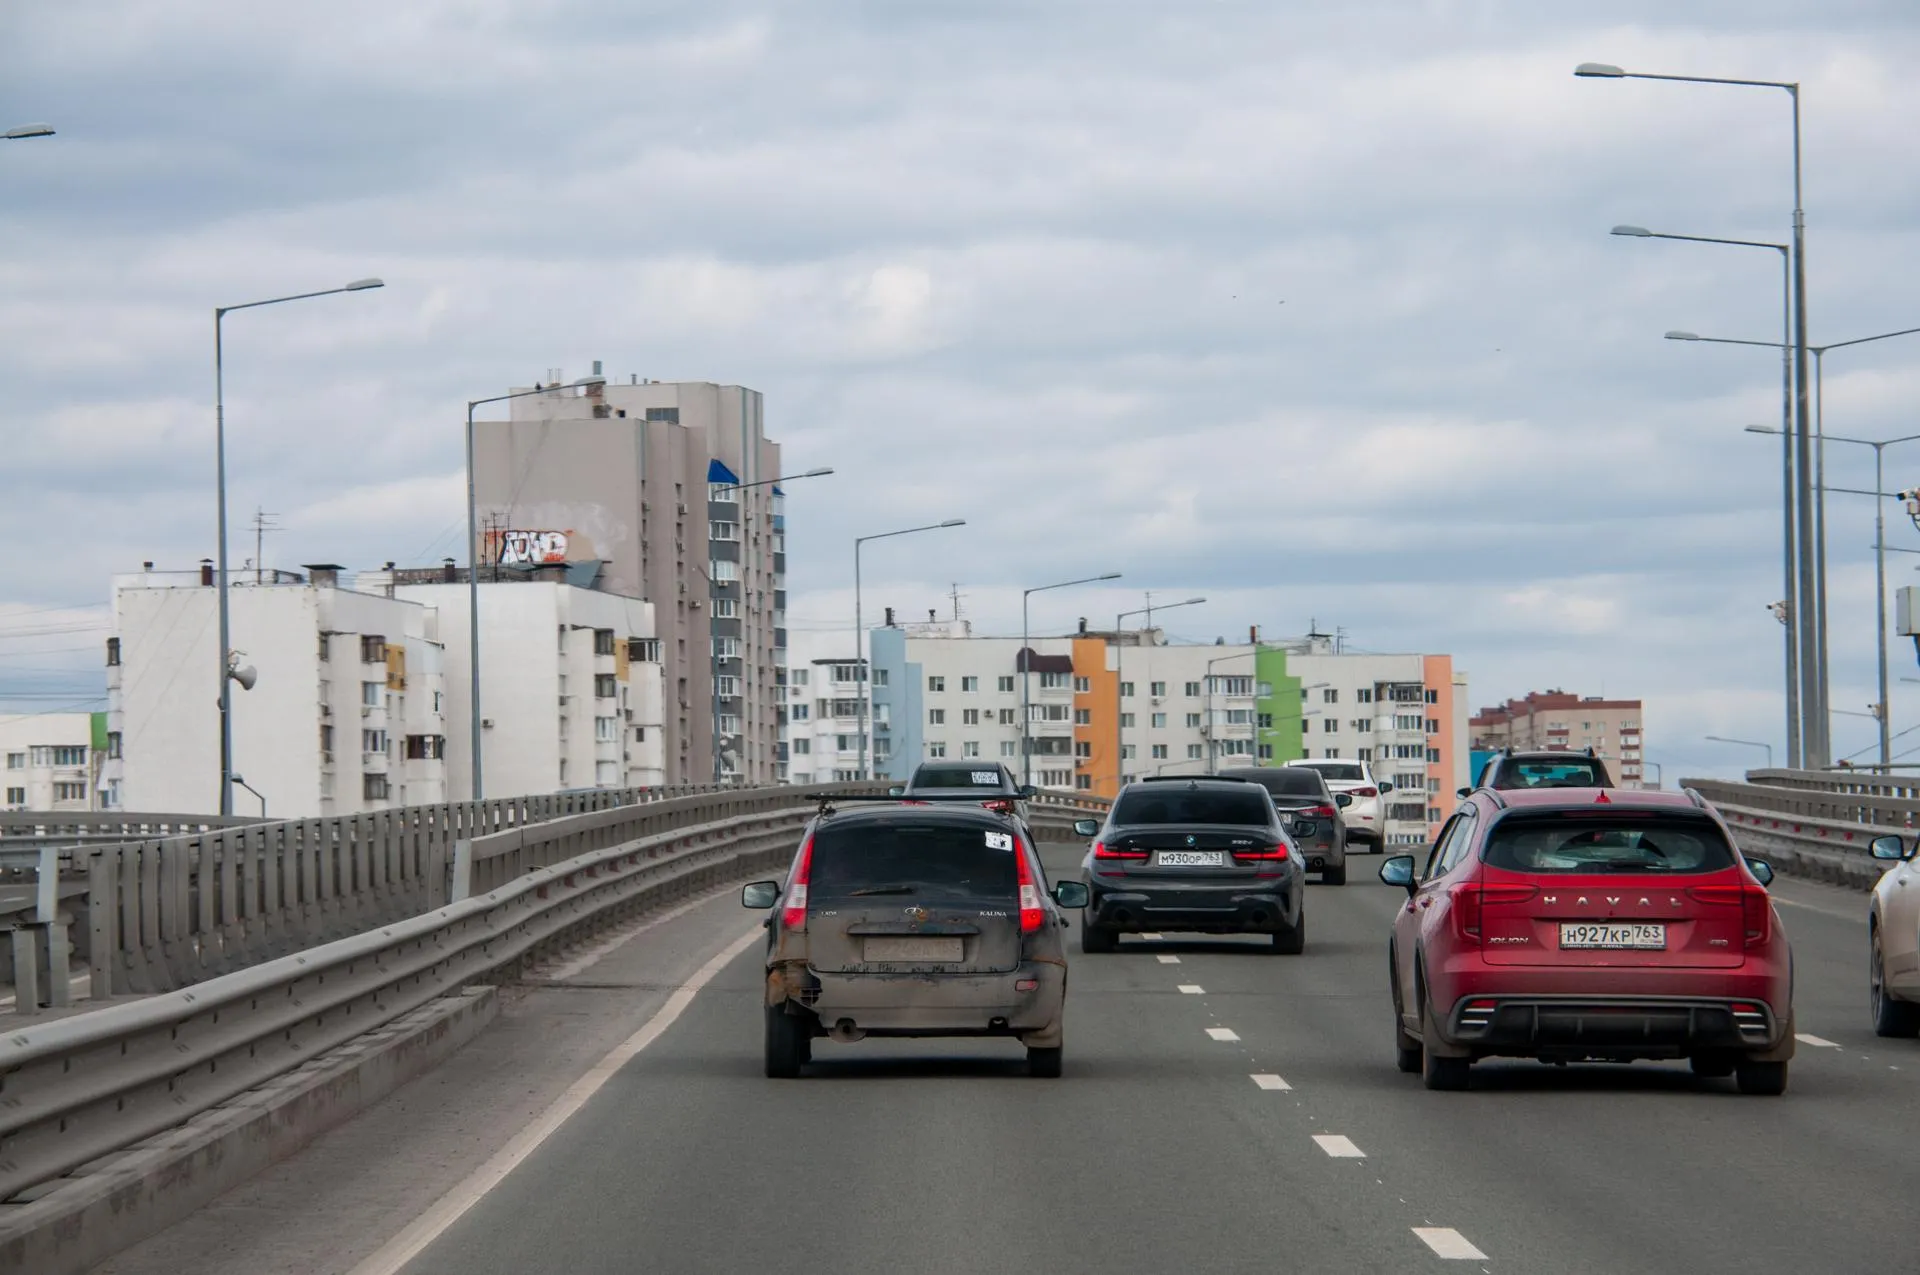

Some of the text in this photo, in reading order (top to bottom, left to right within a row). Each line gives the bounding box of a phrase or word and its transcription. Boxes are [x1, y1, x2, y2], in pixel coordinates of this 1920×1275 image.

[1543, 896, 1682, 906] HAVAL
[1567, 926, 1631, 942] Н927КР
[1634, 925, 1661, 938] 763
